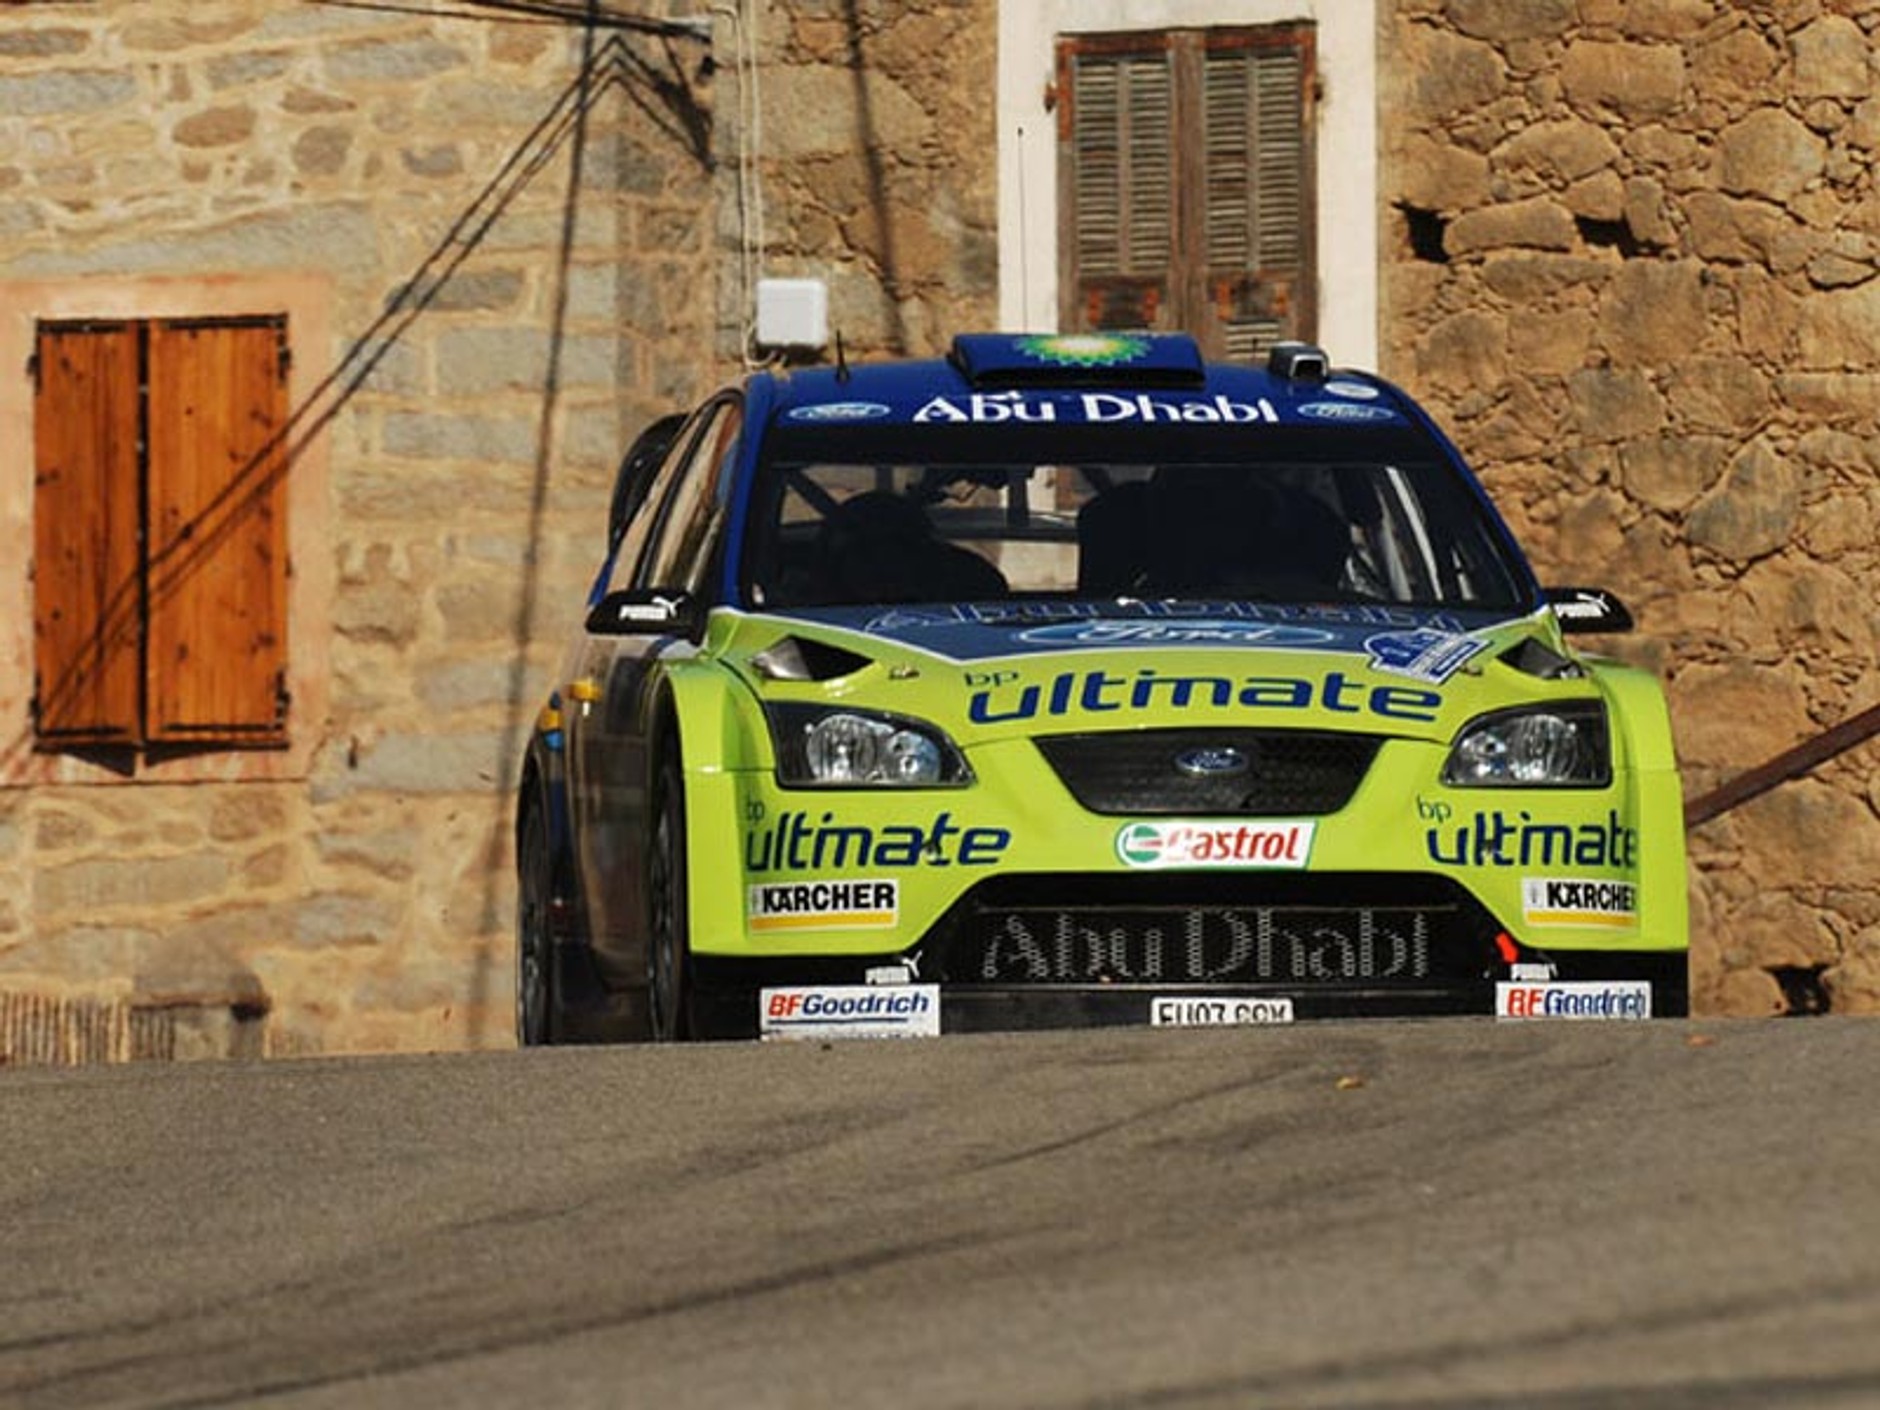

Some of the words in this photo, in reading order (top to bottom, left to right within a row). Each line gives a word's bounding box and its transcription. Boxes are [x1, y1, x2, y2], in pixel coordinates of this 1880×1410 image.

[913, 391, 1056, 422] Abu
[1081, 394, 1279, 422] Dhabi
[965, 671, 1019, 686] bp
[968, 670, 1442, 724] ultimate
[1418, 795, 1452, 823] bp
[746, 811, 1012, 871] ultimate
[981, 913, 1163, 978] Abu
[1186, 908, 1427, 978] Dhabi
[768, 992, 929, 1016] BFGoodrich
